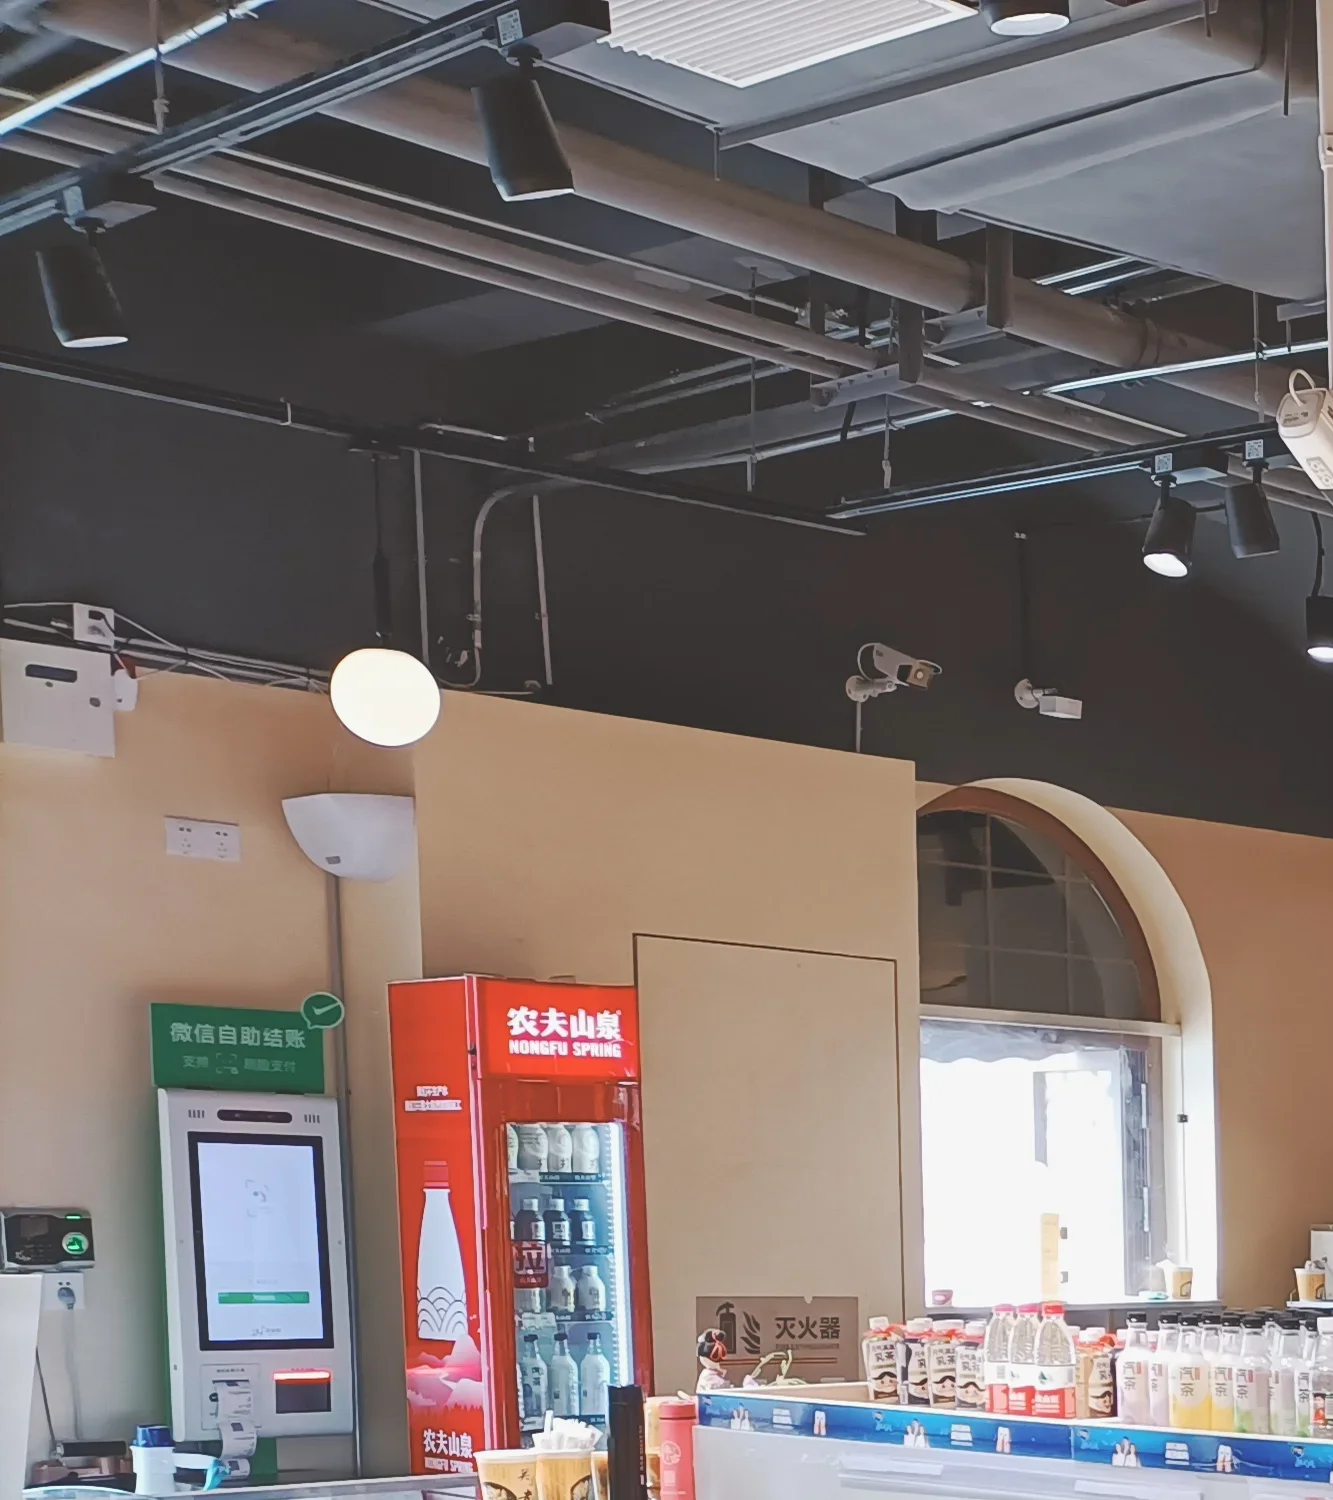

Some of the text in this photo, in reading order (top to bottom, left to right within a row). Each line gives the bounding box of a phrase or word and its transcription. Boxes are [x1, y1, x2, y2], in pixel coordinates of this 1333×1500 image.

[170, 1022, 306, 1049] 微信自助结账
[507, 1005, 622, 1041] 农夫山泉
[509, 1039, 622, 1058] NONGFU SPRING
[774, 1316, 840, 1339] 灭火器
[423, 1429, 472, 1458] 农夫山泉
